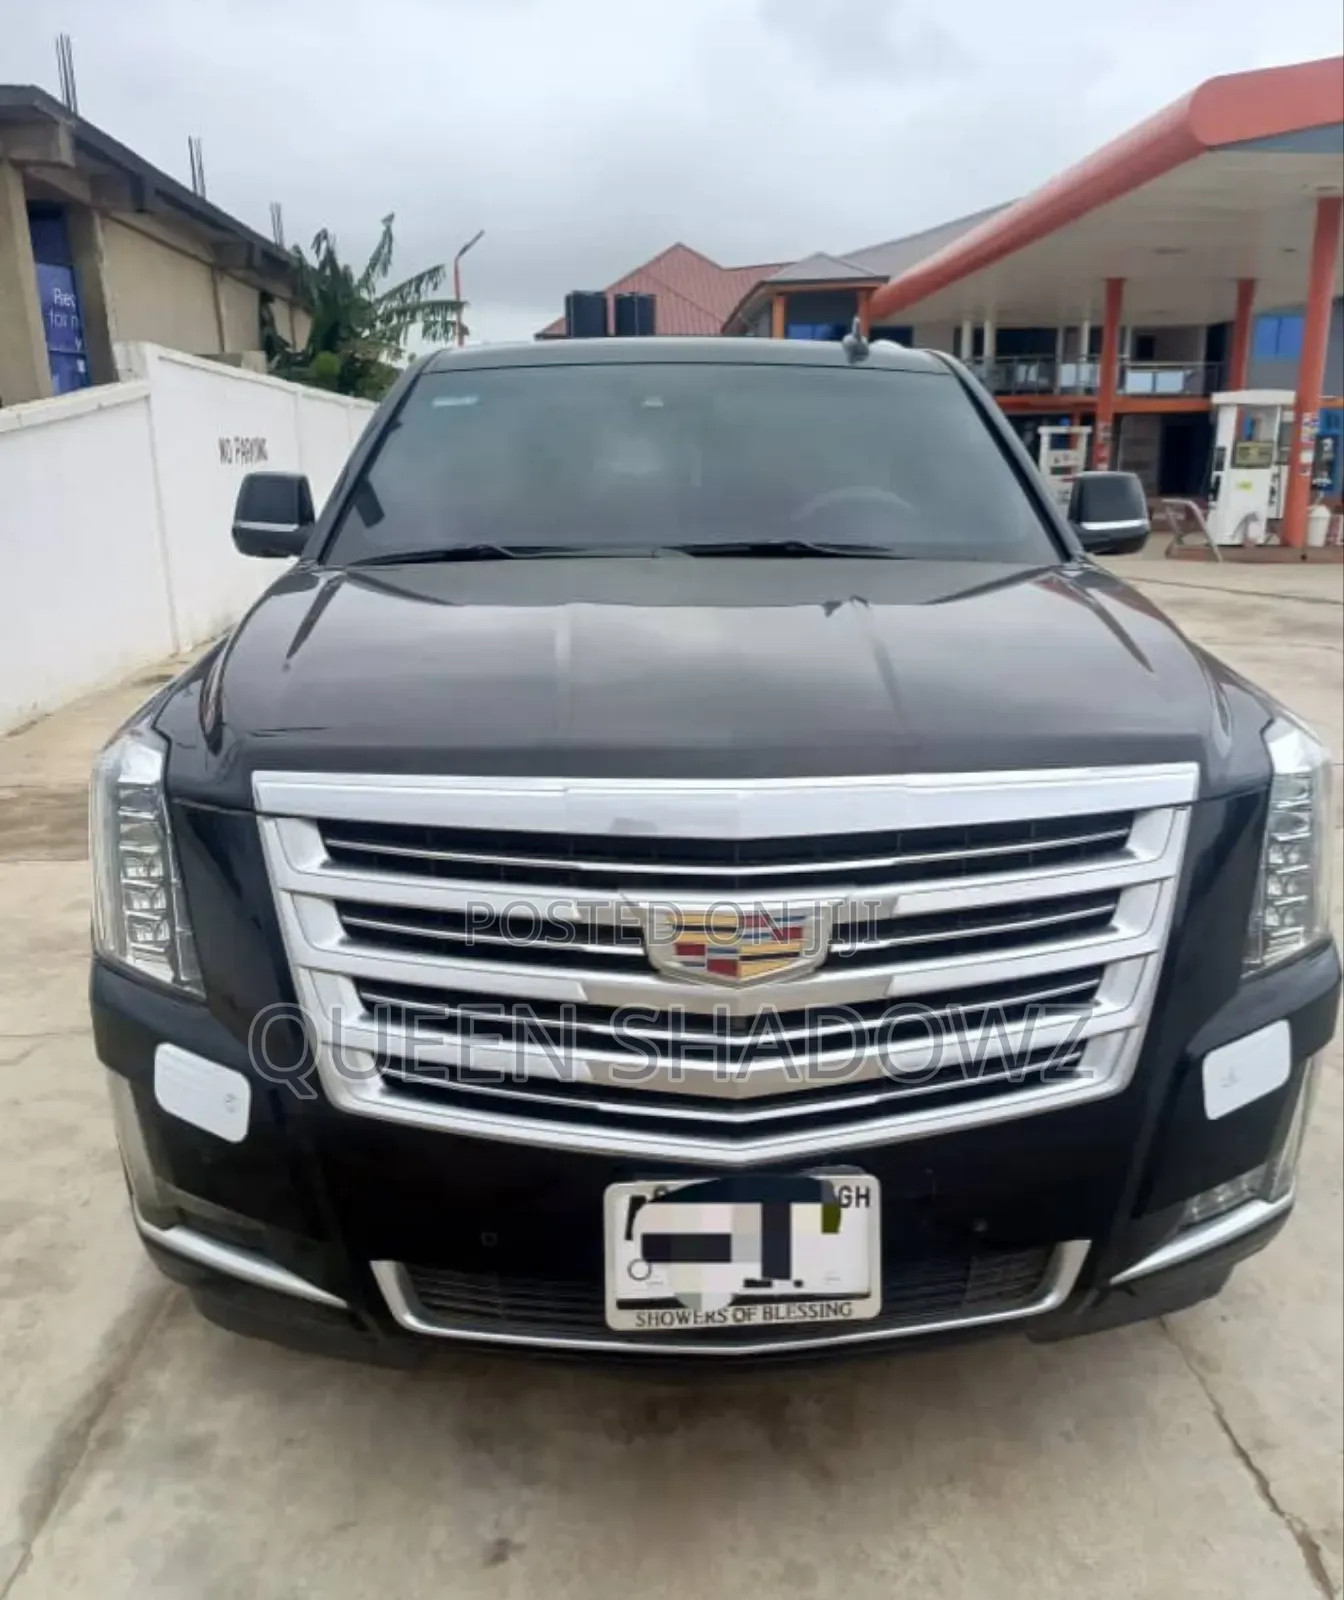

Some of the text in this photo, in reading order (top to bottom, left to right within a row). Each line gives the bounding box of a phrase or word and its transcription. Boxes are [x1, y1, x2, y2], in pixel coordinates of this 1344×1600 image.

[218, 436, 232, 464] NO
[635, 1301, 853, 1327] SHOWERS OF BLESSING
